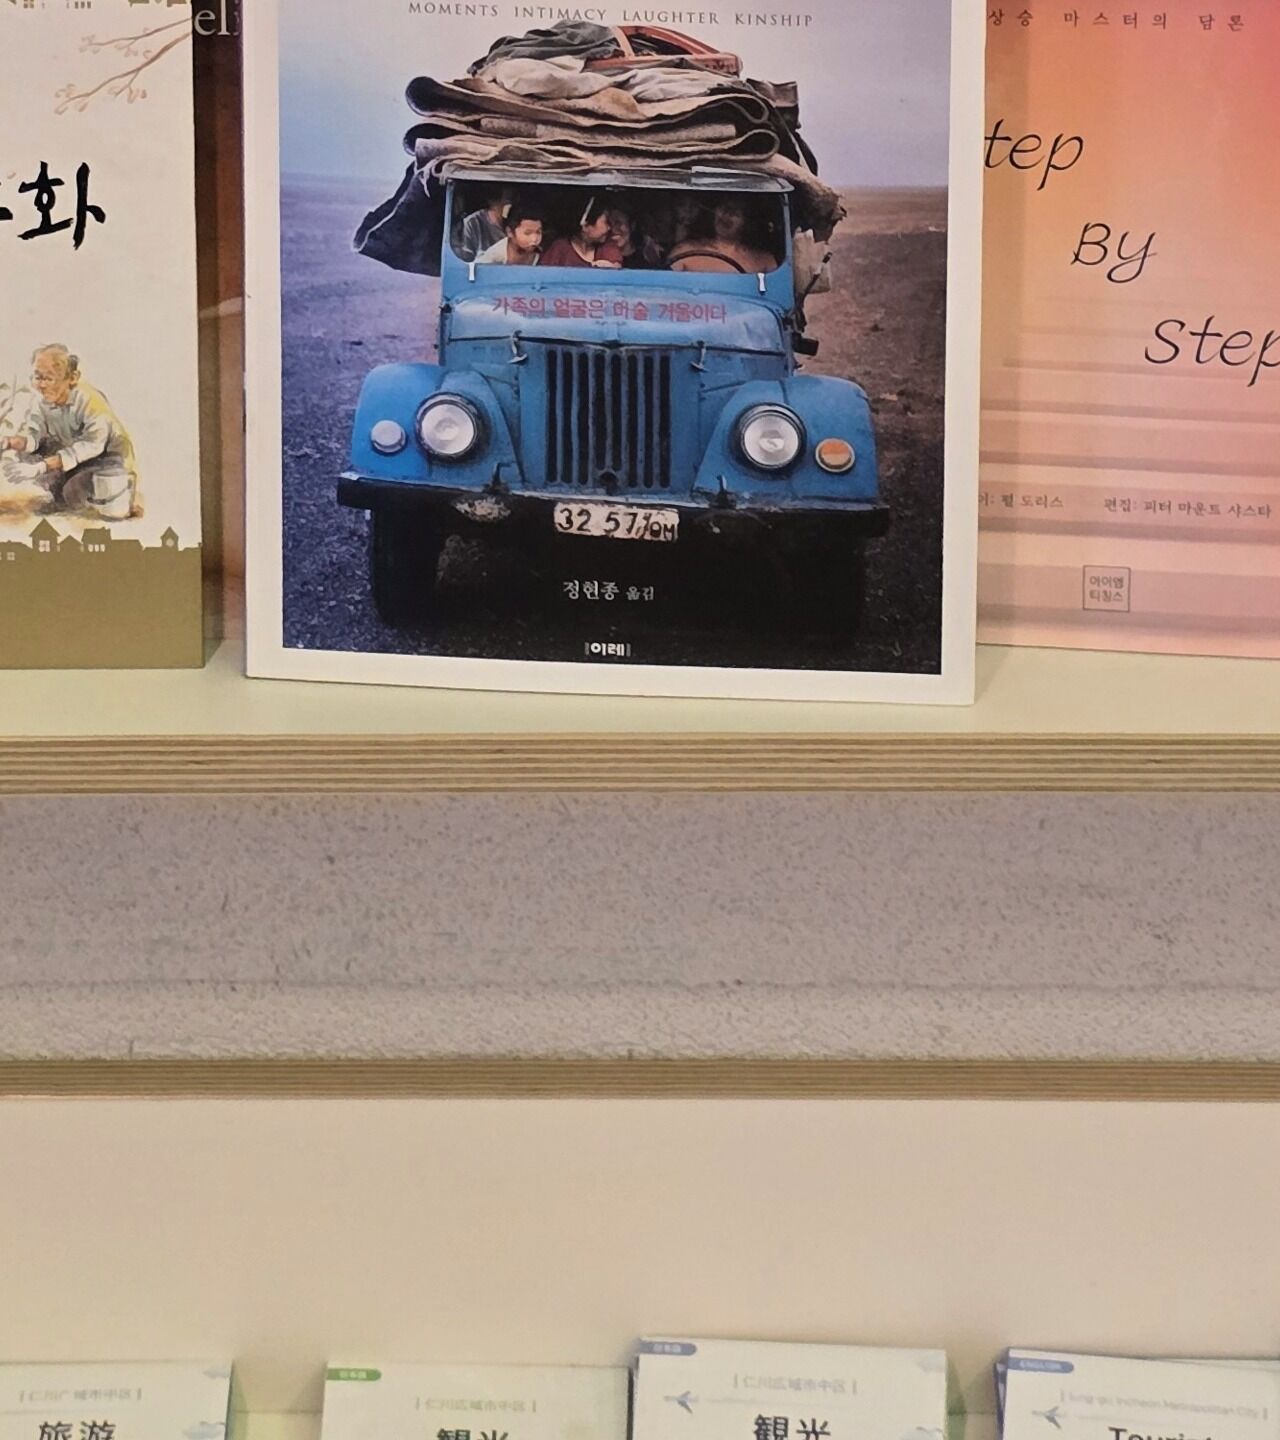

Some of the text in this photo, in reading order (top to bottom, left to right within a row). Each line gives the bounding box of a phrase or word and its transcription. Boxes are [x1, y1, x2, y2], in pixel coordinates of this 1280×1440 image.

[408, 1, 815, 28] MOMENTS INTIMACY LAUGHTER KINSHIP
[1062, 9, 1246, 32] 마스터의 담론
[984, 119, 1084, 191] tep
[1071, 222, 1158, 284] By
[491, 296, 728, 324] 가족의 거울이다
[1021, 493, 1065, 509] 도리스
[1144, 499, 1173, 514] 피터
[1177, 501, 1222, 517] 마운트
[558, 507, 592, 533] 32
[562, 579, 655, 601] 정현종 옮김
